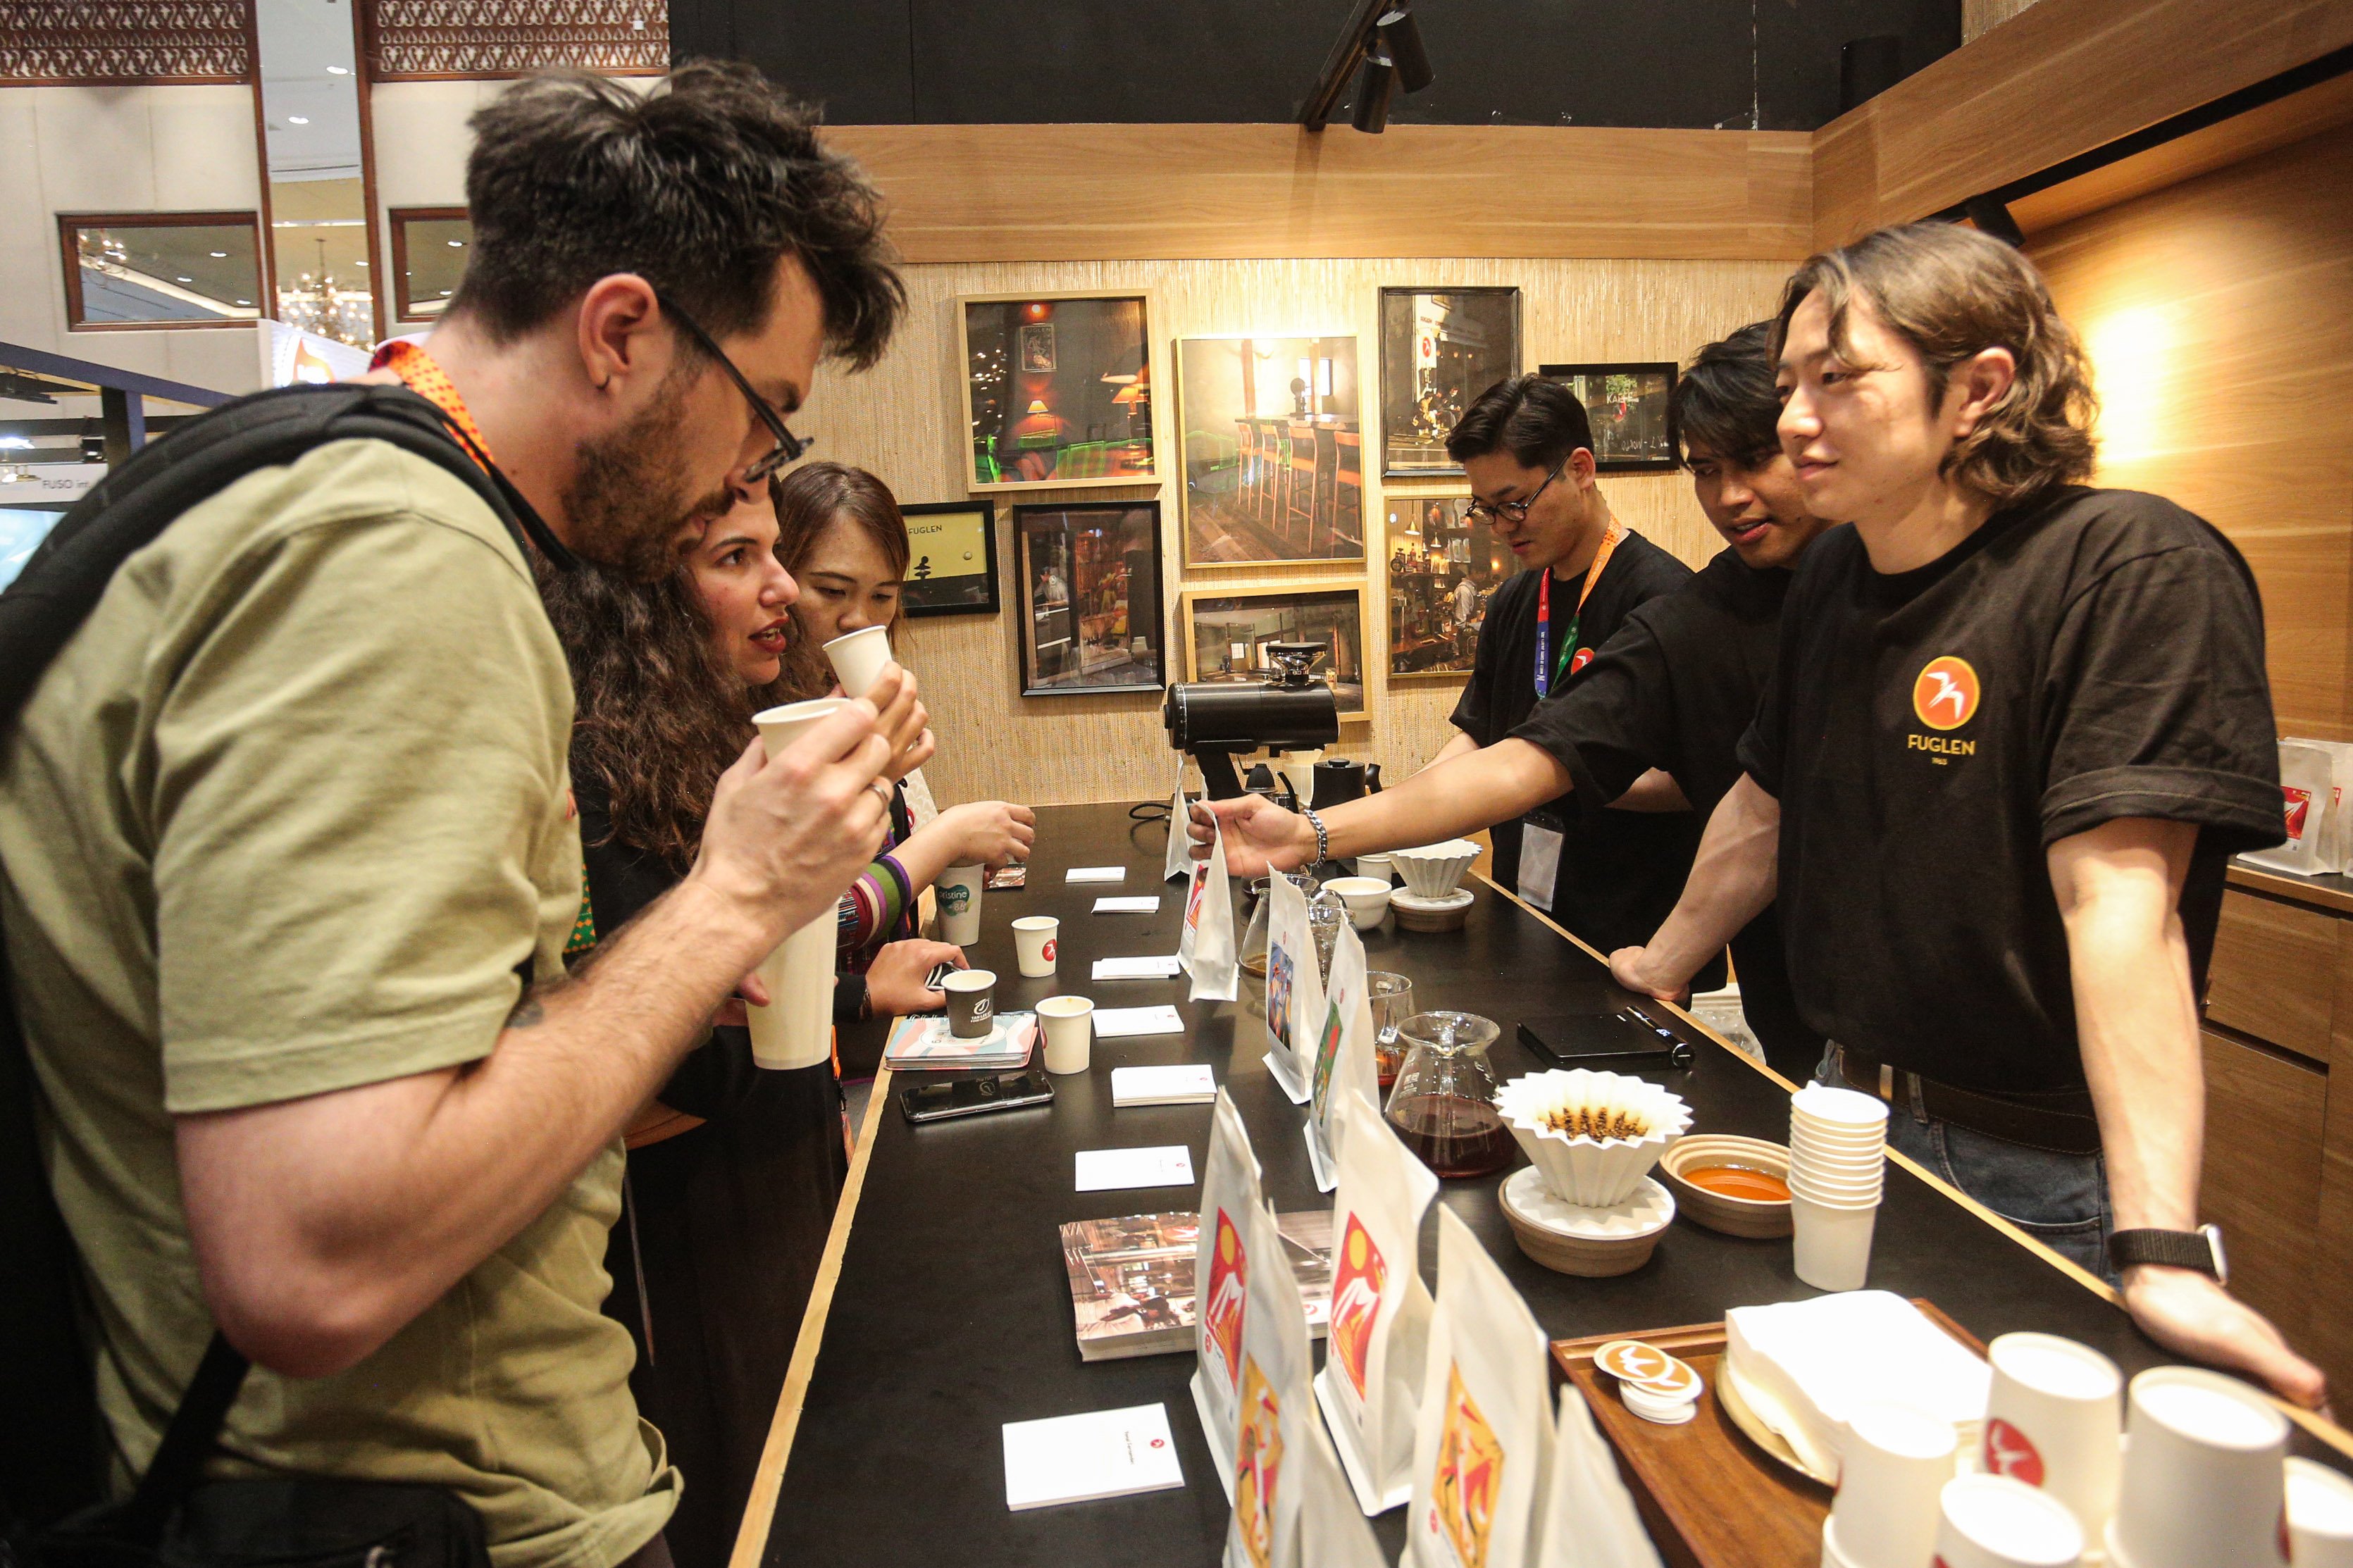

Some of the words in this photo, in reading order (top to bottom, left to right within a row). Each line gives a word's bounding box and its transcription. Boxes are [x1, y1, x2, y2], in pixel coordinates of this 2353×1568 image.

[42, 479, 73, 489] FUSO
[908, 524, 943, 535] FUGLEN
[1907, 734, 1977, 756] FUGLEN
